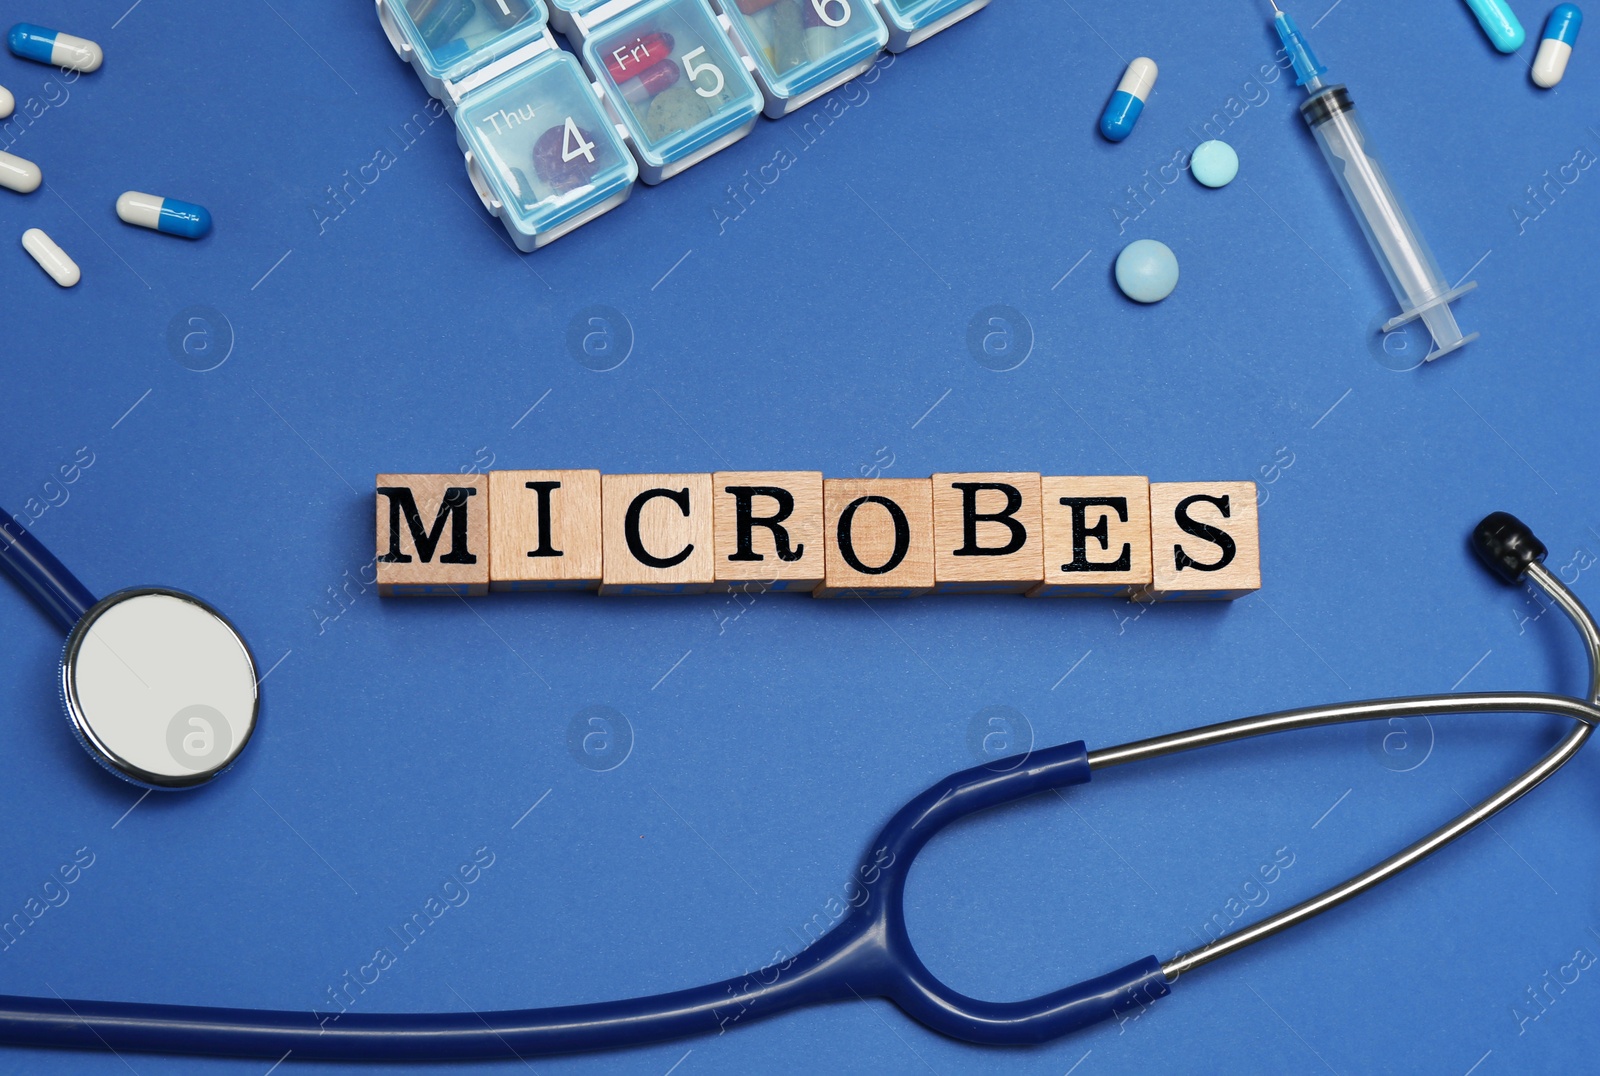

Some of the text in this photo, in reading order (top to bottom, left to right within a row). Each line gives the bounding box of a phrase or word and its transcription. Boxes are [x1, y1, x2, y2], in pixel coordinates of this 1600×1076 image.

[811, 0, 851, 27] 6
[612, 38, 649, 71] Fri
[682, 46, 725, 97] 5
[483, 104, 536, 136] Thu
[562, 117, 595, 163] 4
[377, 481, 1236, 575] MICROBES
